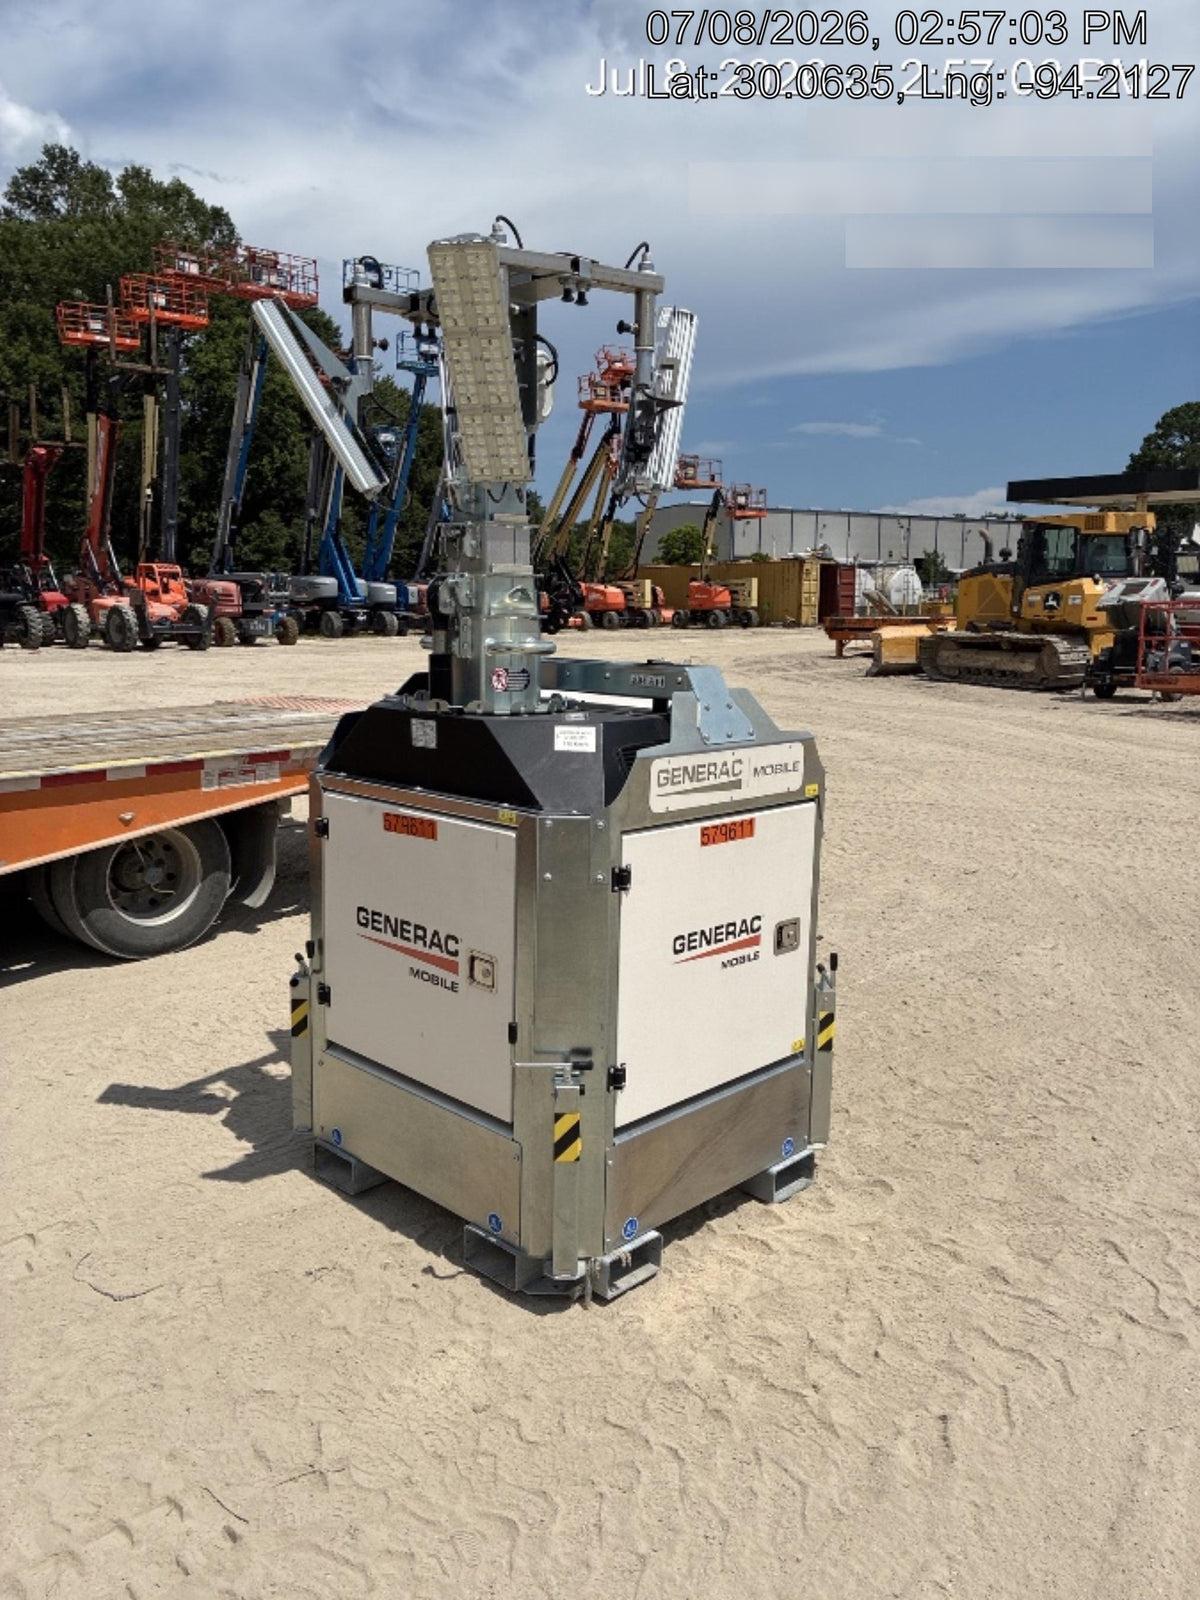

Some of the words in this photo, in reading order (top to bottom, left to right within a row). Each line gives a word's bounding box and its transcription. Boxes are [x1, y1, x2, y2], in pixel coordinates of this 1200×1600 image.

[657, 758, 743, 788] GENERAC
[753, 760, 801, 778] MOBILE
[701, 818, 755, 846] 579611
[356, 906, 460, 957] GENERAC
[673, 915, 762, 955] GENERAC
[721, 950, 760, 969] MOBILE
[409, 966, 459, 993] MOBILE
